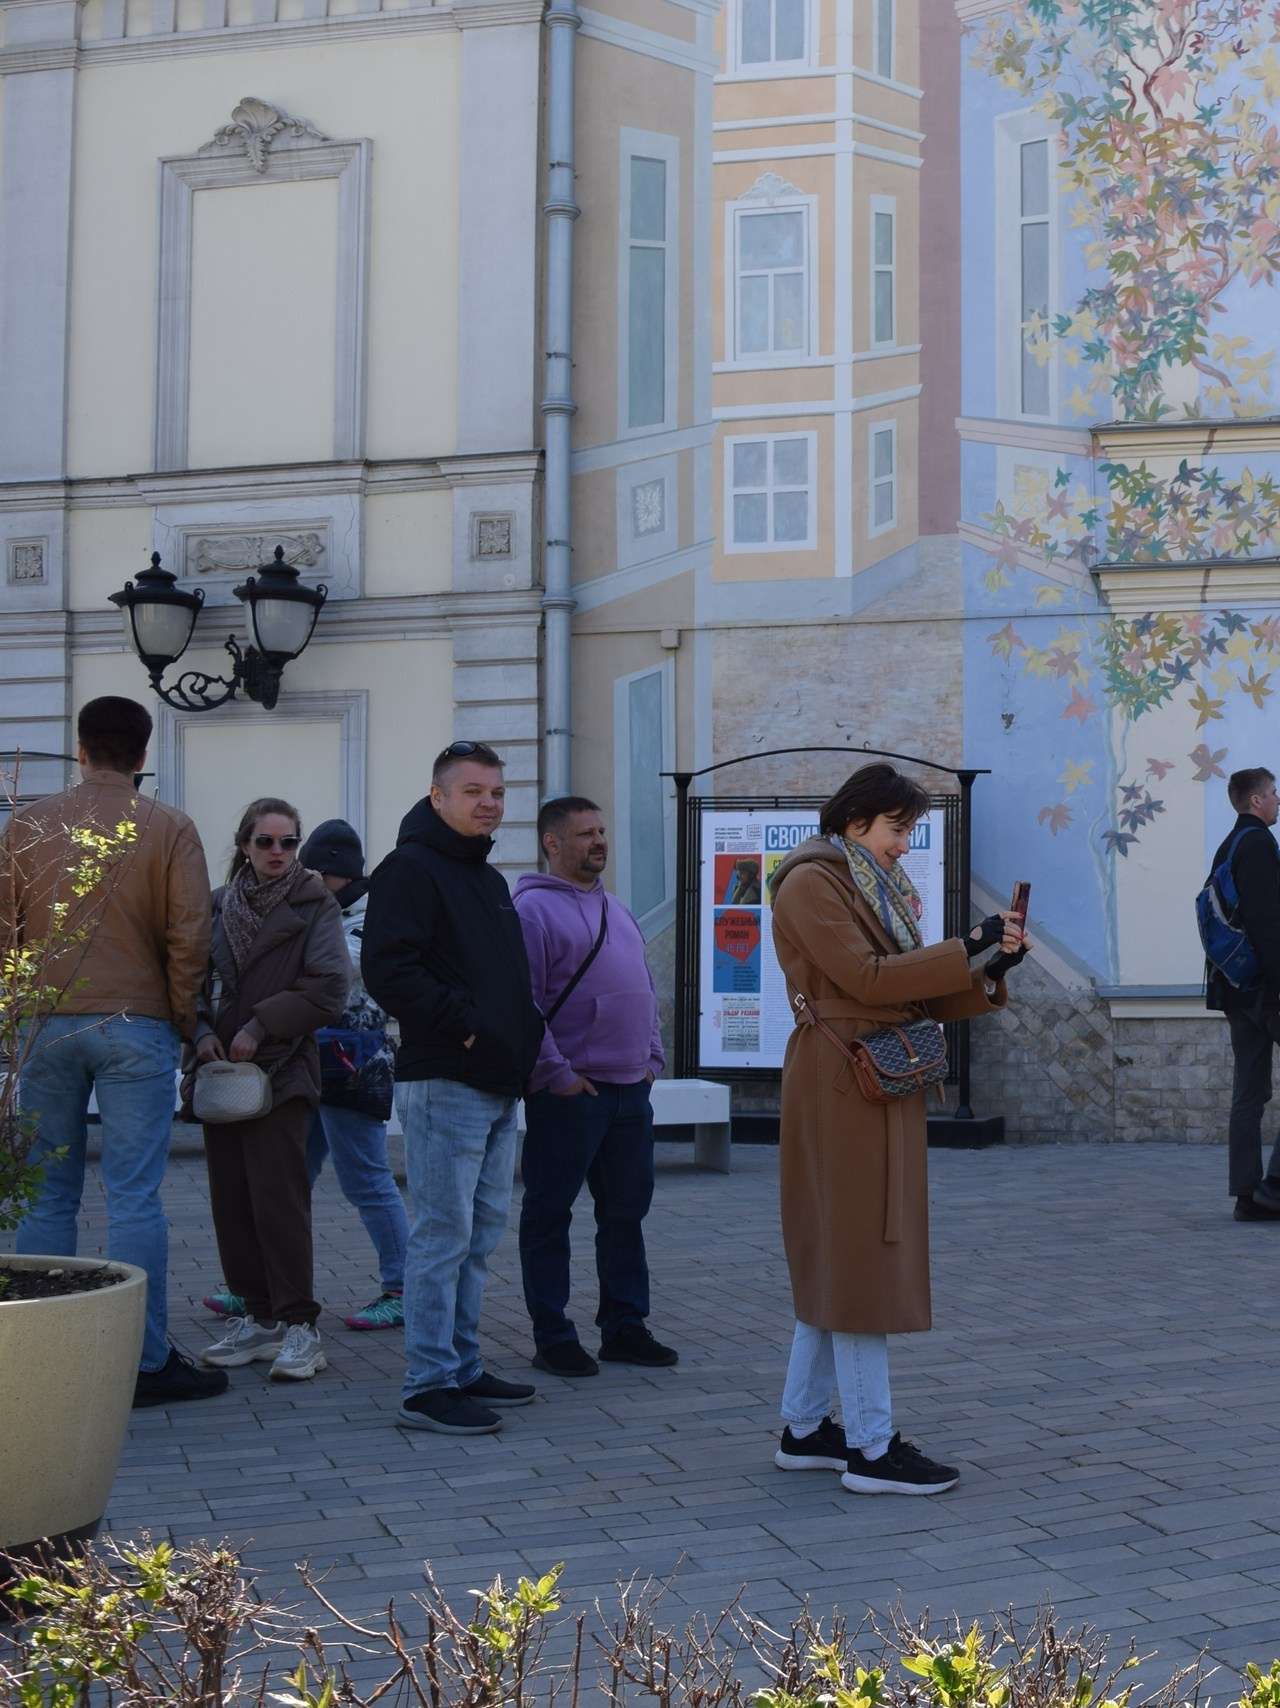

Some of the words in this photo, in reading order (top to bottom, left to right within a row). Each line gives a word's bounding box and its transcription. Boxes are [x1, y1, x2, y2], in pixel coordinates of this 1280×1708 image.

[768, 826, 819, 848] СВОИ
[714, 915, 761, 926] СЛУЖЕБНЫЙ
[725, 930, 750, 940] РОМАН
[736, 943, 749, 952] ЛЕТ
